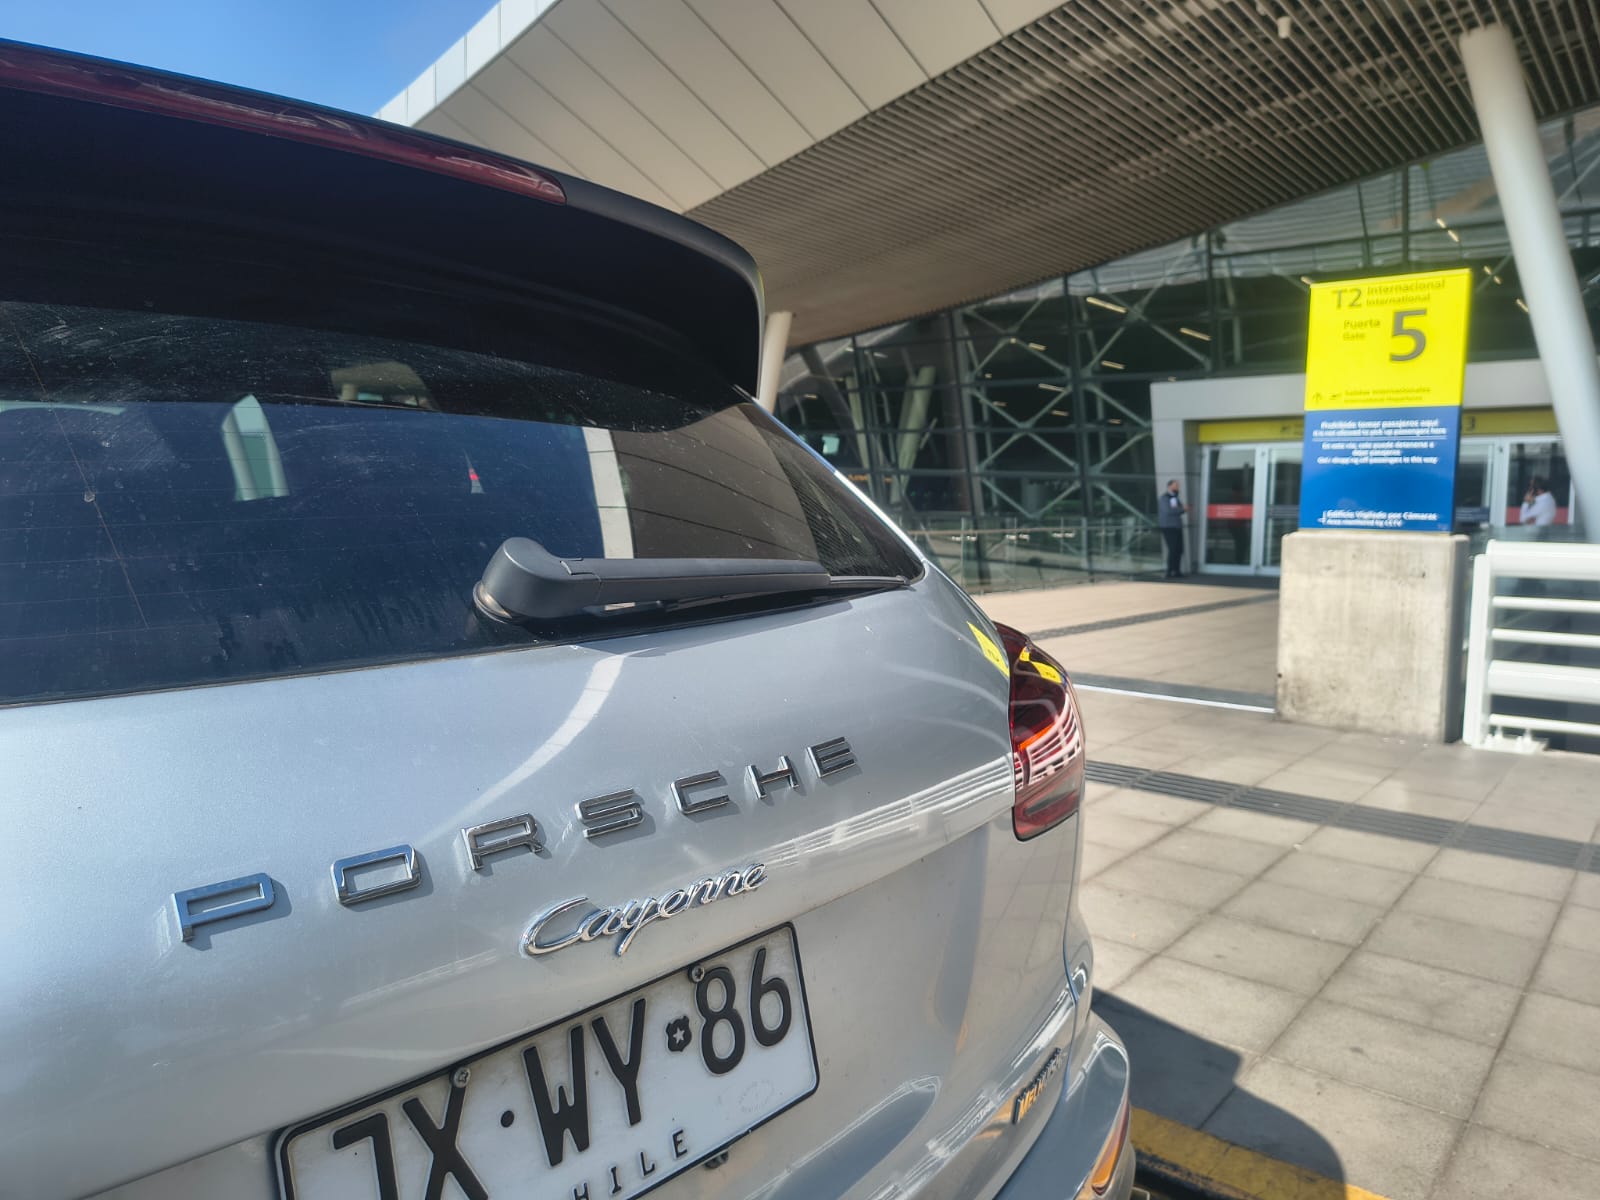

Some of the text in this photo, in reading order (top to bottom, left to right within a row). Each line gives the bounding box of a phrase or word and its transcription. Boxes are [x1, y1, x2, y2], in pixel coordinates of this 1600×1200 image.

[1332, 288, 1362, 309] T2
[1367, 280, 1445, 296] Internacional
[1367, 293, 1430, 306] International
[1344, 319, 1381, 330] Puerta
[1390, 308, 1427, 362] 5
[171, 736, 856, 943] PORSCHE
[521, 862, 768, 957] Cayenne
